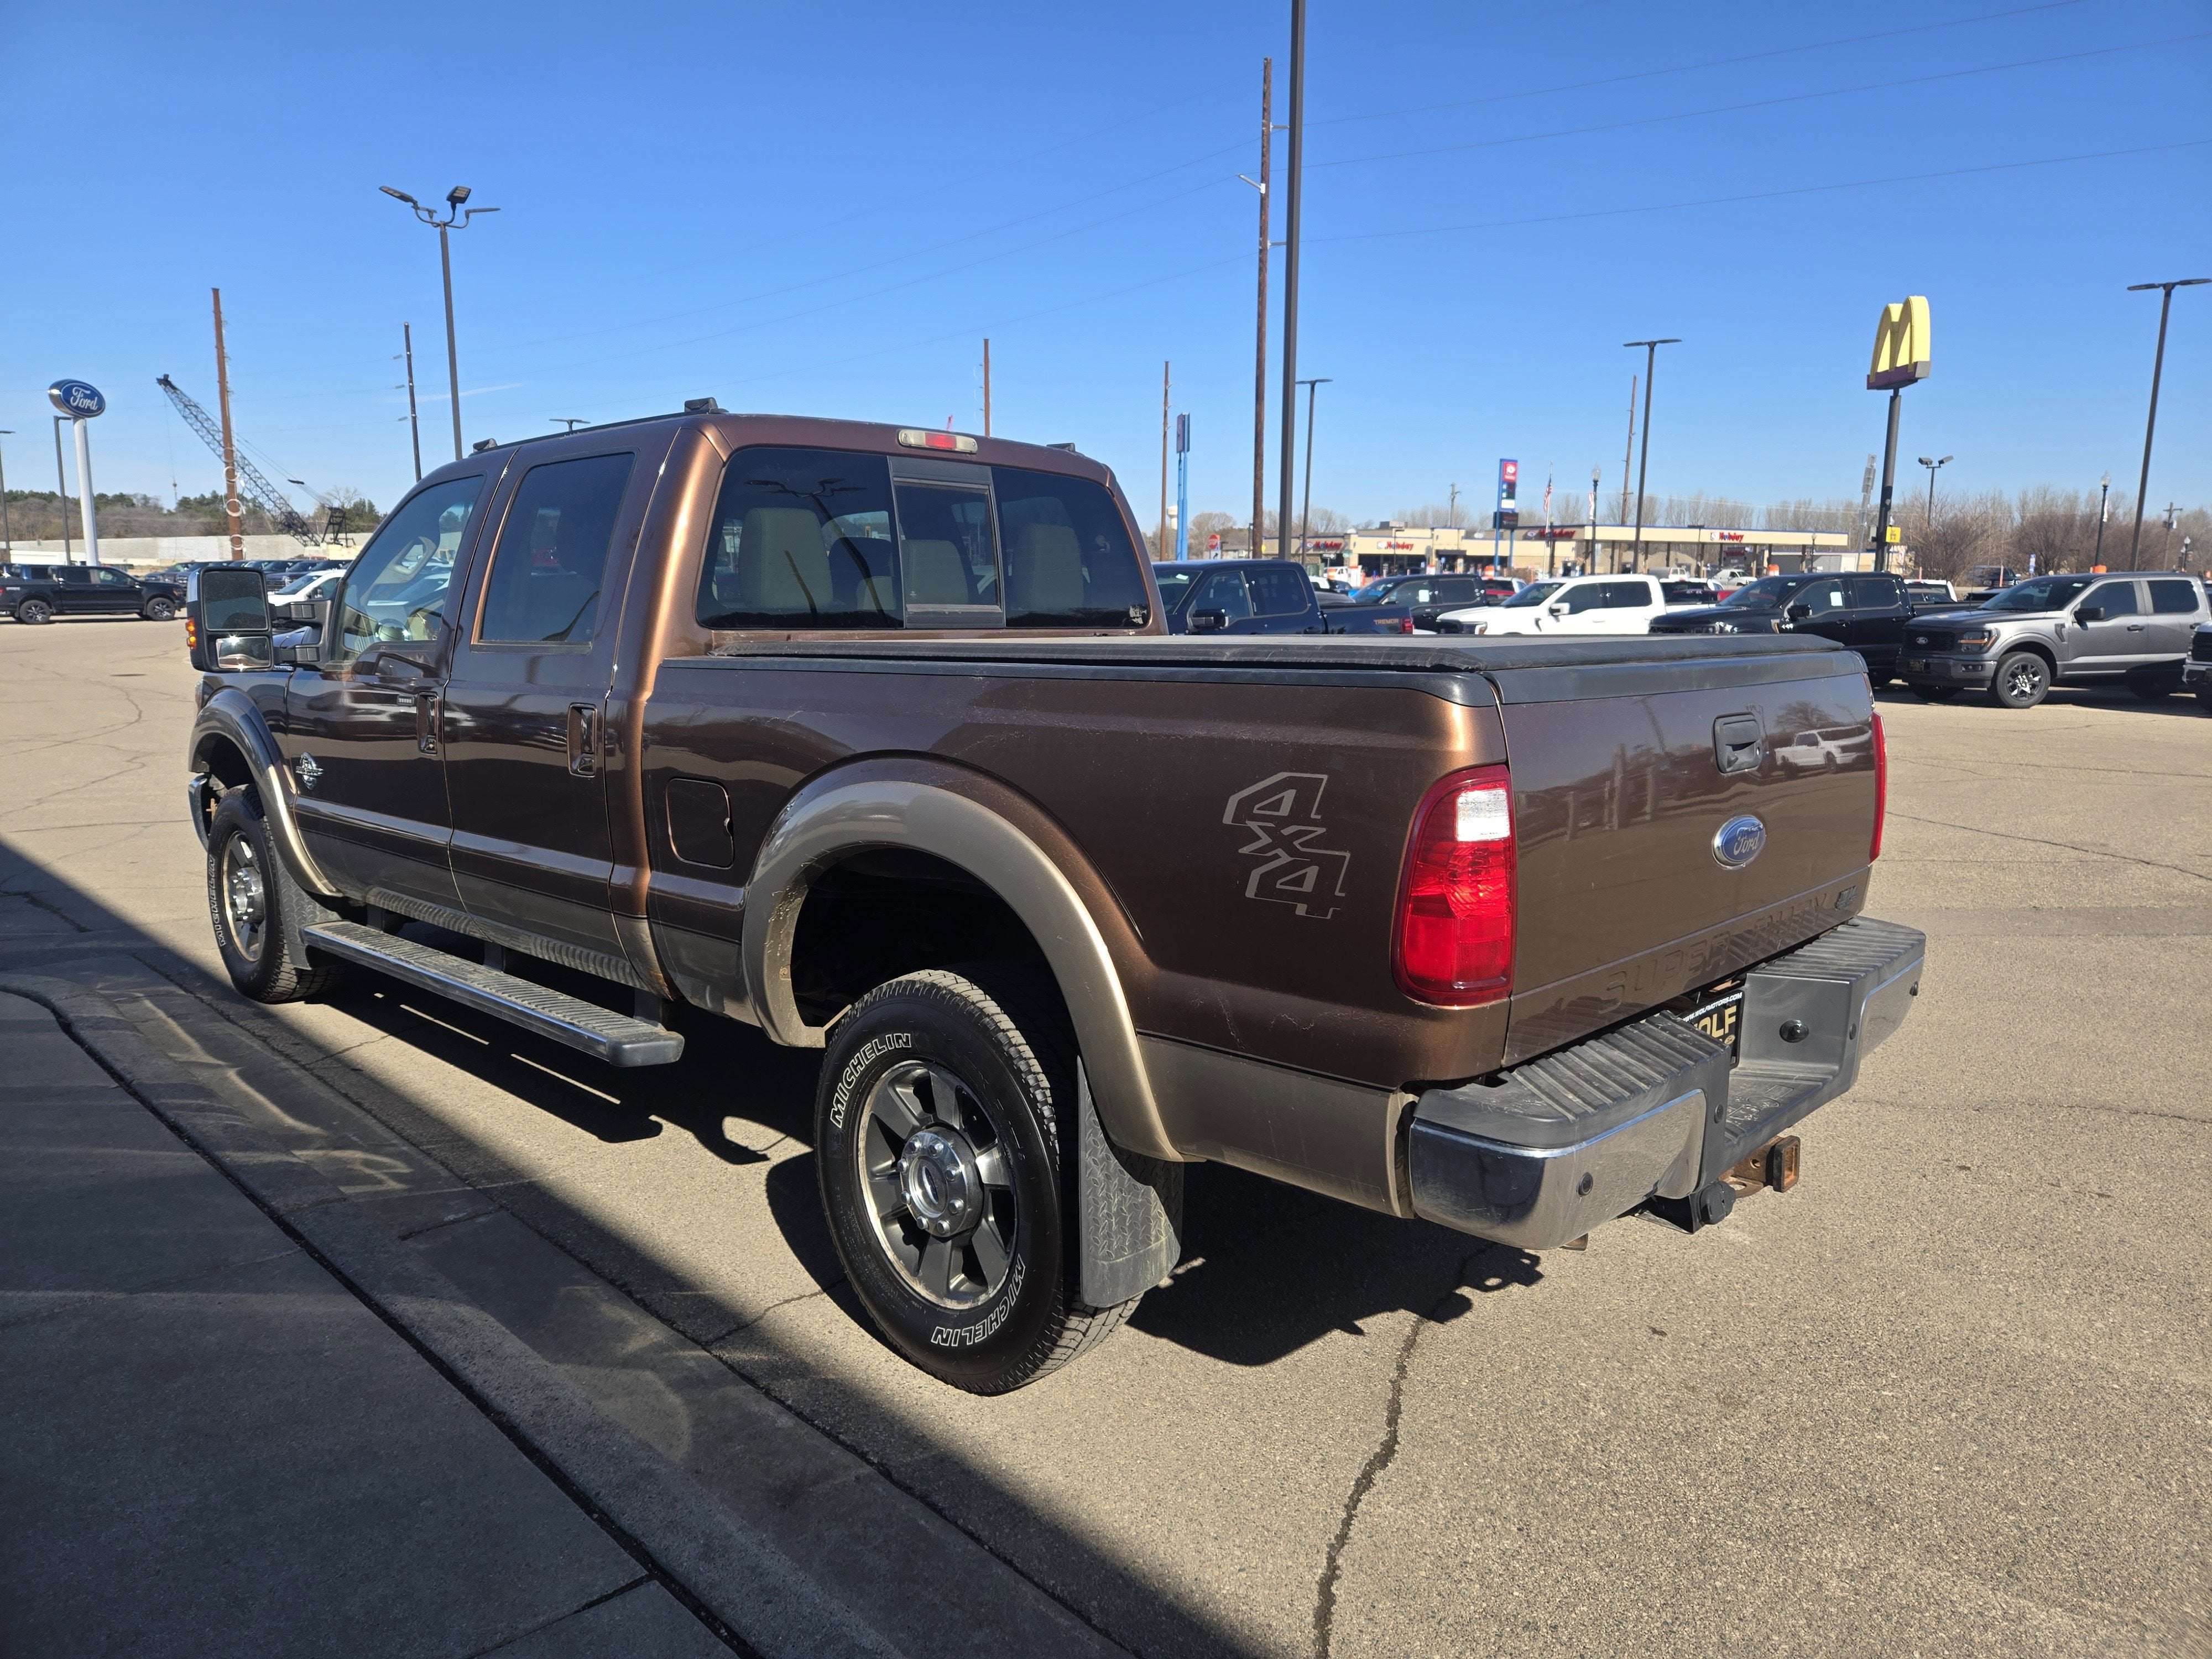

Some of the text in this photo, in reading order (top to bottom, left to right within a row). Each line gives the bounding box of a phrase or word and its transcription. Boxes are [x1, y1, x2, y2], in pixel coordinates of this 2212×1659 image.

[70, 386, 98, 410] Ford
[1733, 826, 1760, 856] Ford
[1598, 930, 1731, 1014] SUPER
[1693, 1005, 1737, 1038] OLF
[830, 1032, 912, 1129] MICHELIN
[930, 1253, 1026, 1347] MICHELIN
